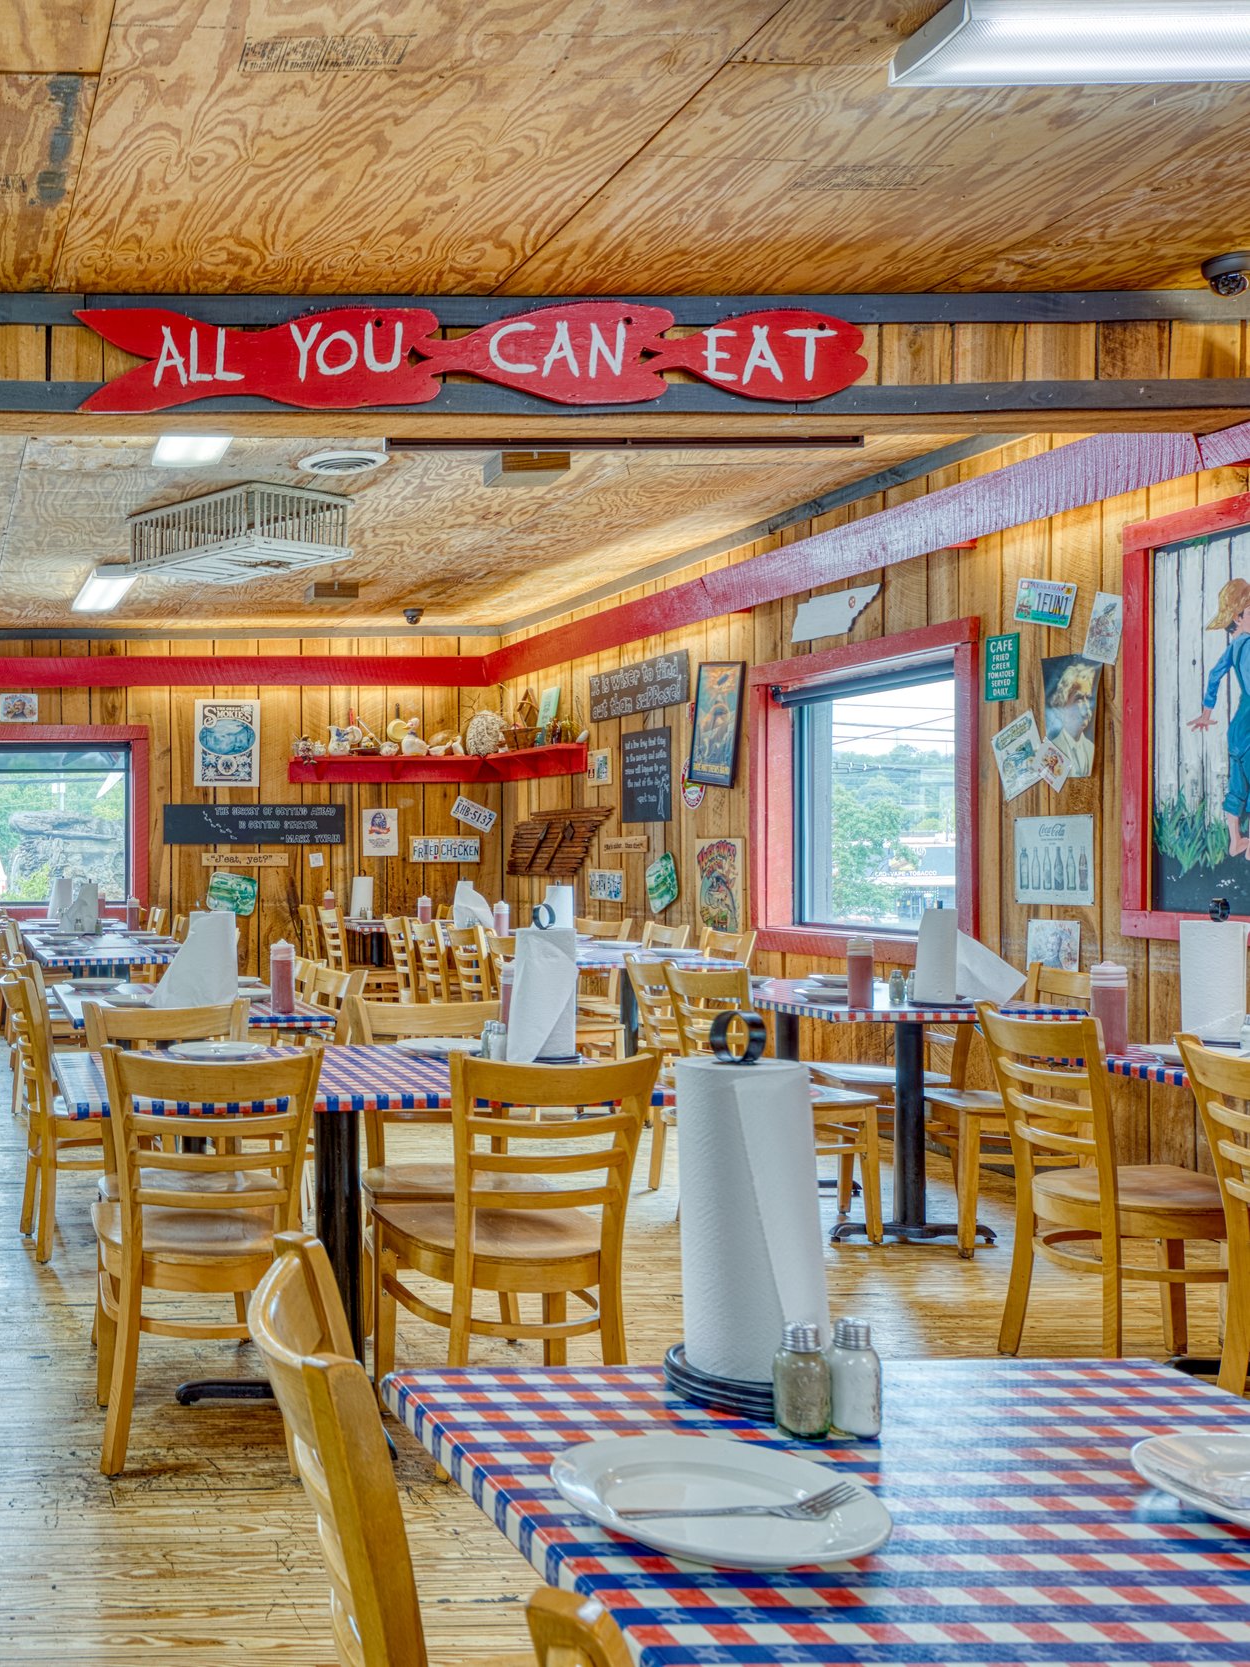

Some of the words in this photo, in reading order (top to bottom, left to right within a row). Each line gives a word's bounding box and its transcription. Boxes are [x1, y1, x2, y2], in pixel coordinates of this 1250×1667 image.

[153, 326, 245, 388] ALL
[290, 321, 403, 381] YOU
[488, 321, 627, 378] CAN
[701, 324, 838, 385] EAT
[989, 639, 1013, 653] CAFE
[992, 653, 1010, 662] FRIED
[991, 662, 1010, 670] GREEN
[601, 674, 609, 694] is
[610, 669, 640, 690] wiser
[642, 663, 654, 683] to
[988, 670, 1015, 679] TOMATOES
[991, 679, 1011, 688] SERVED
[992, 688, 1009, 696] DAILY
[592, 699, 608, 719] out
[610, 693, 632, 716] than
[204, 706, 252, 728] SMOKIES
[215, 807, 229, 816] THE
[232, 807, 259, 816] SECRET
[263, 807, 272, 816] OF
[275, 807, 308, 816] GETTING
[310, 807, 336, 816] AHEAD
[455, 801, 492, 827] KHB-5137
[239, 821, 246, 829] IS
[248, 820, 280, 829] GETTING
[314, 834, 341, 843] TWAIN
[413, 845, 439, 858] FRIED
[440, 844, 479, 858] CHICKEN
